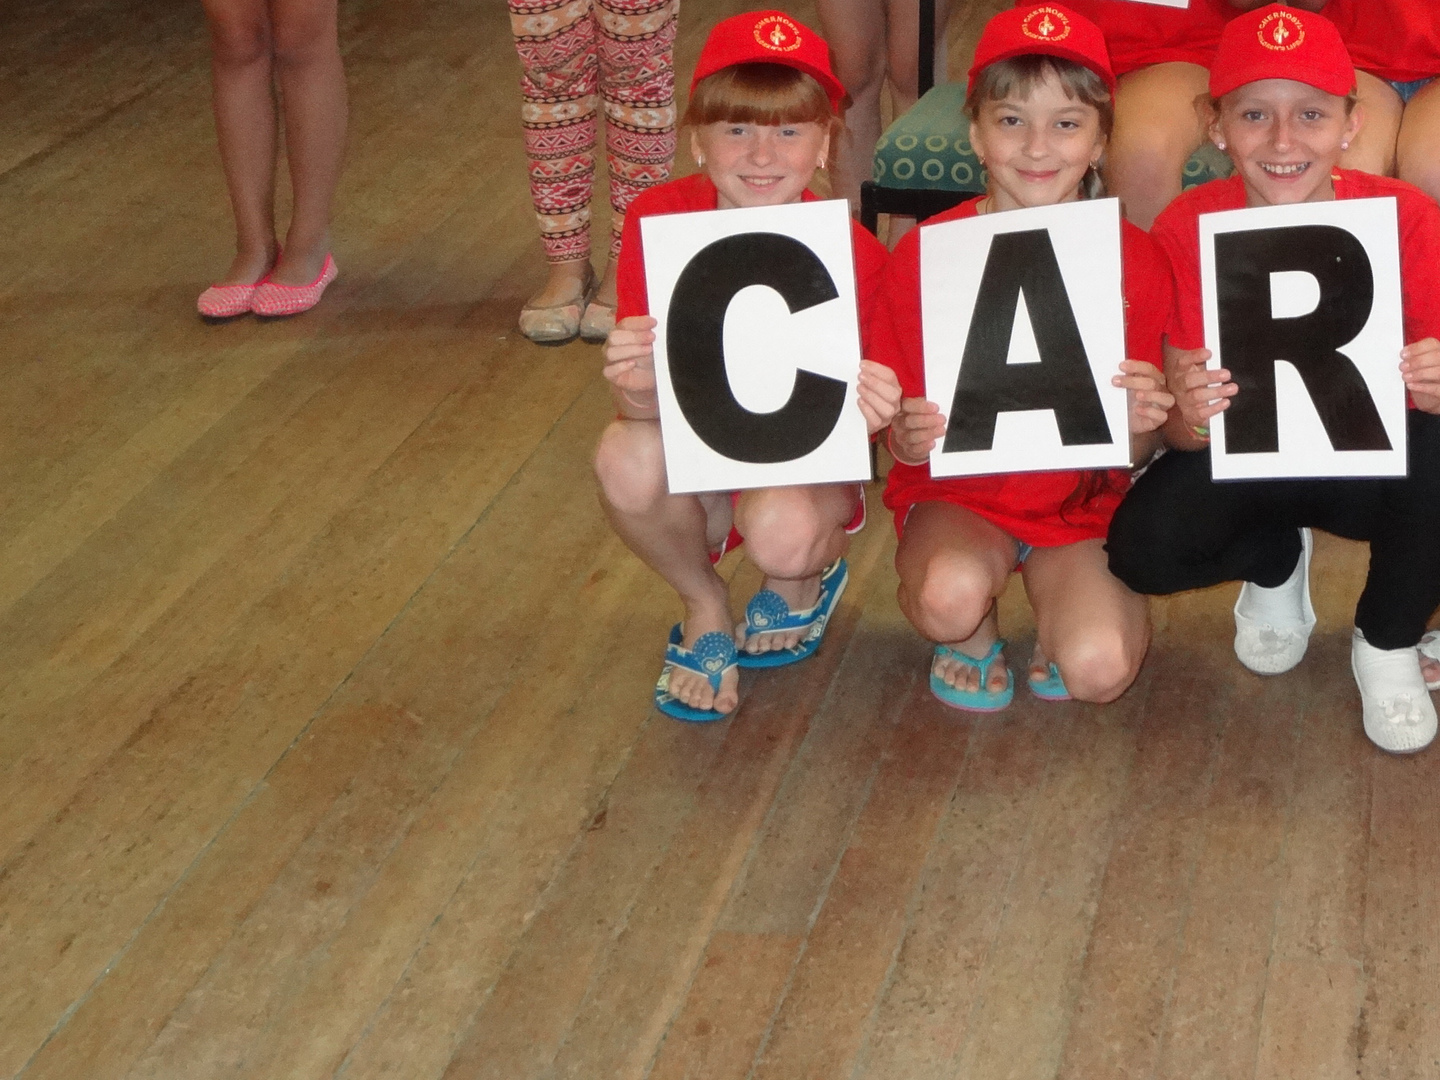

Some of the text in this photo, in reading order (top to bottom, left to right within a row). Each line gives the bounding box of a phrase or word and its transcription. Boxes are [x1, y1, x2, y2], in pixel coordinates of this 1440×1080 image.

[1258, 11, 1303, 30] CHERNOBYL
[666, 232, 848, 464] C
[941, 228, 1113, 454] A
[1214, 224, 1393, 454] R
